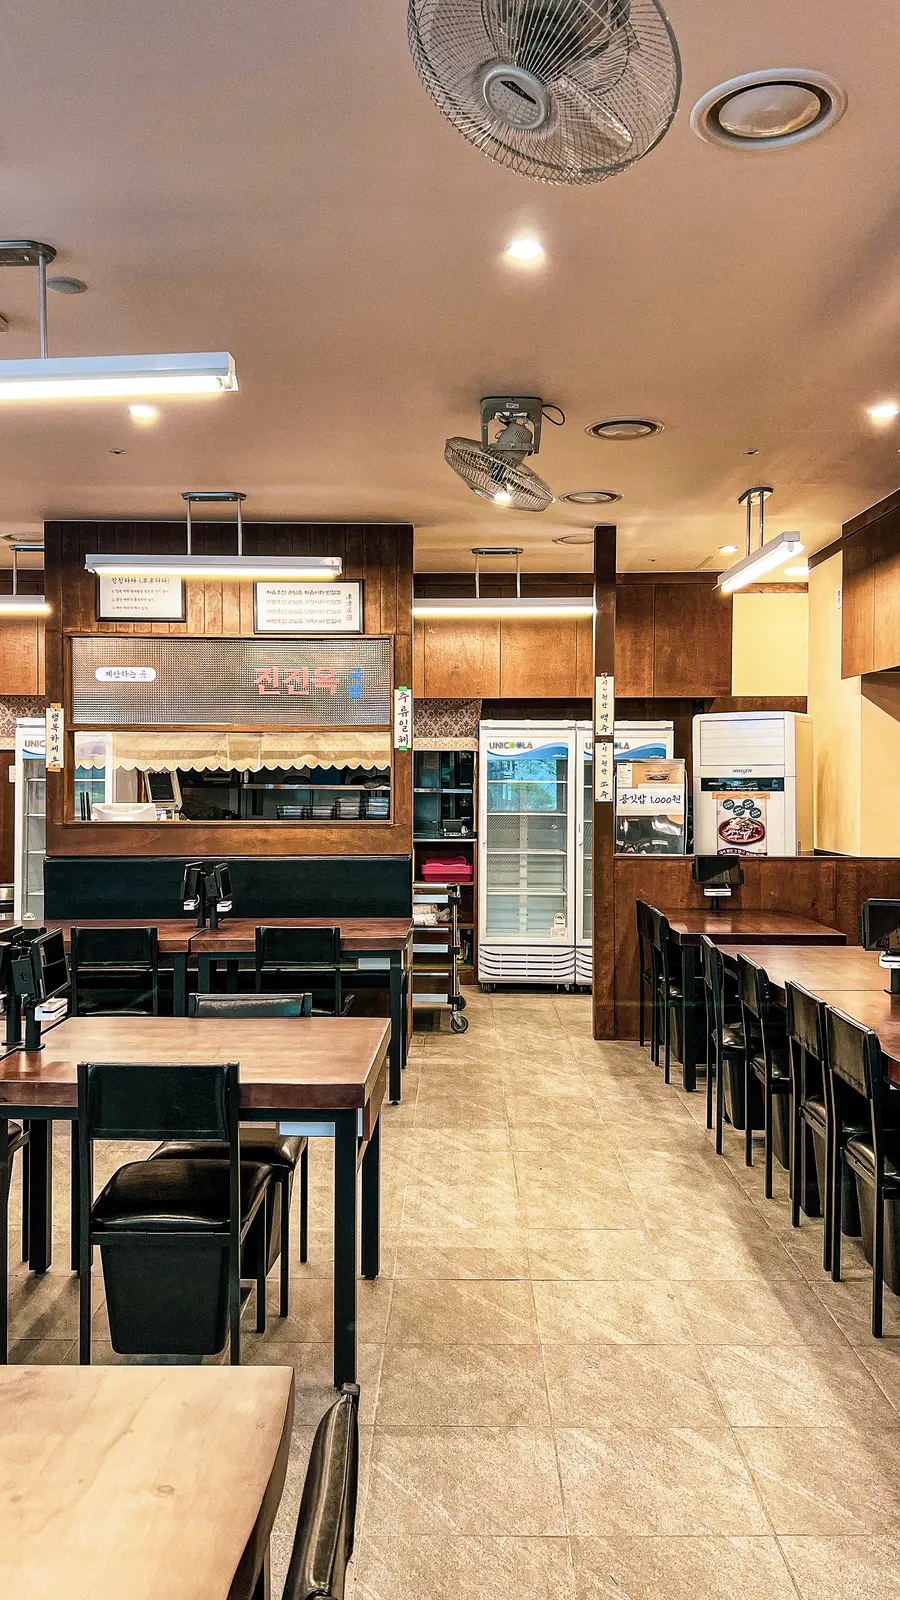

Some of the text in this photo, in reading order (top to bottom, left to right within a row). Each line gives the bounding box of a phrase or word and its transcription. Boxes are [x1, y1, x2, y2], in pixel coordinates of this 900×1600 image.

[105, 669, 137, 679] 계산하는
[254, 666, 340, 696] 진진옥
[398, 691, 410, 746] 주류일체
[600, 713, 610, 733] 맥주
[24, 739, 46, 748] UNIC
[50, 712, 60, 763] 행복하세요
[600, 781, 609, 799] 소주
[619, 793, 647, 804] 공깃밥
